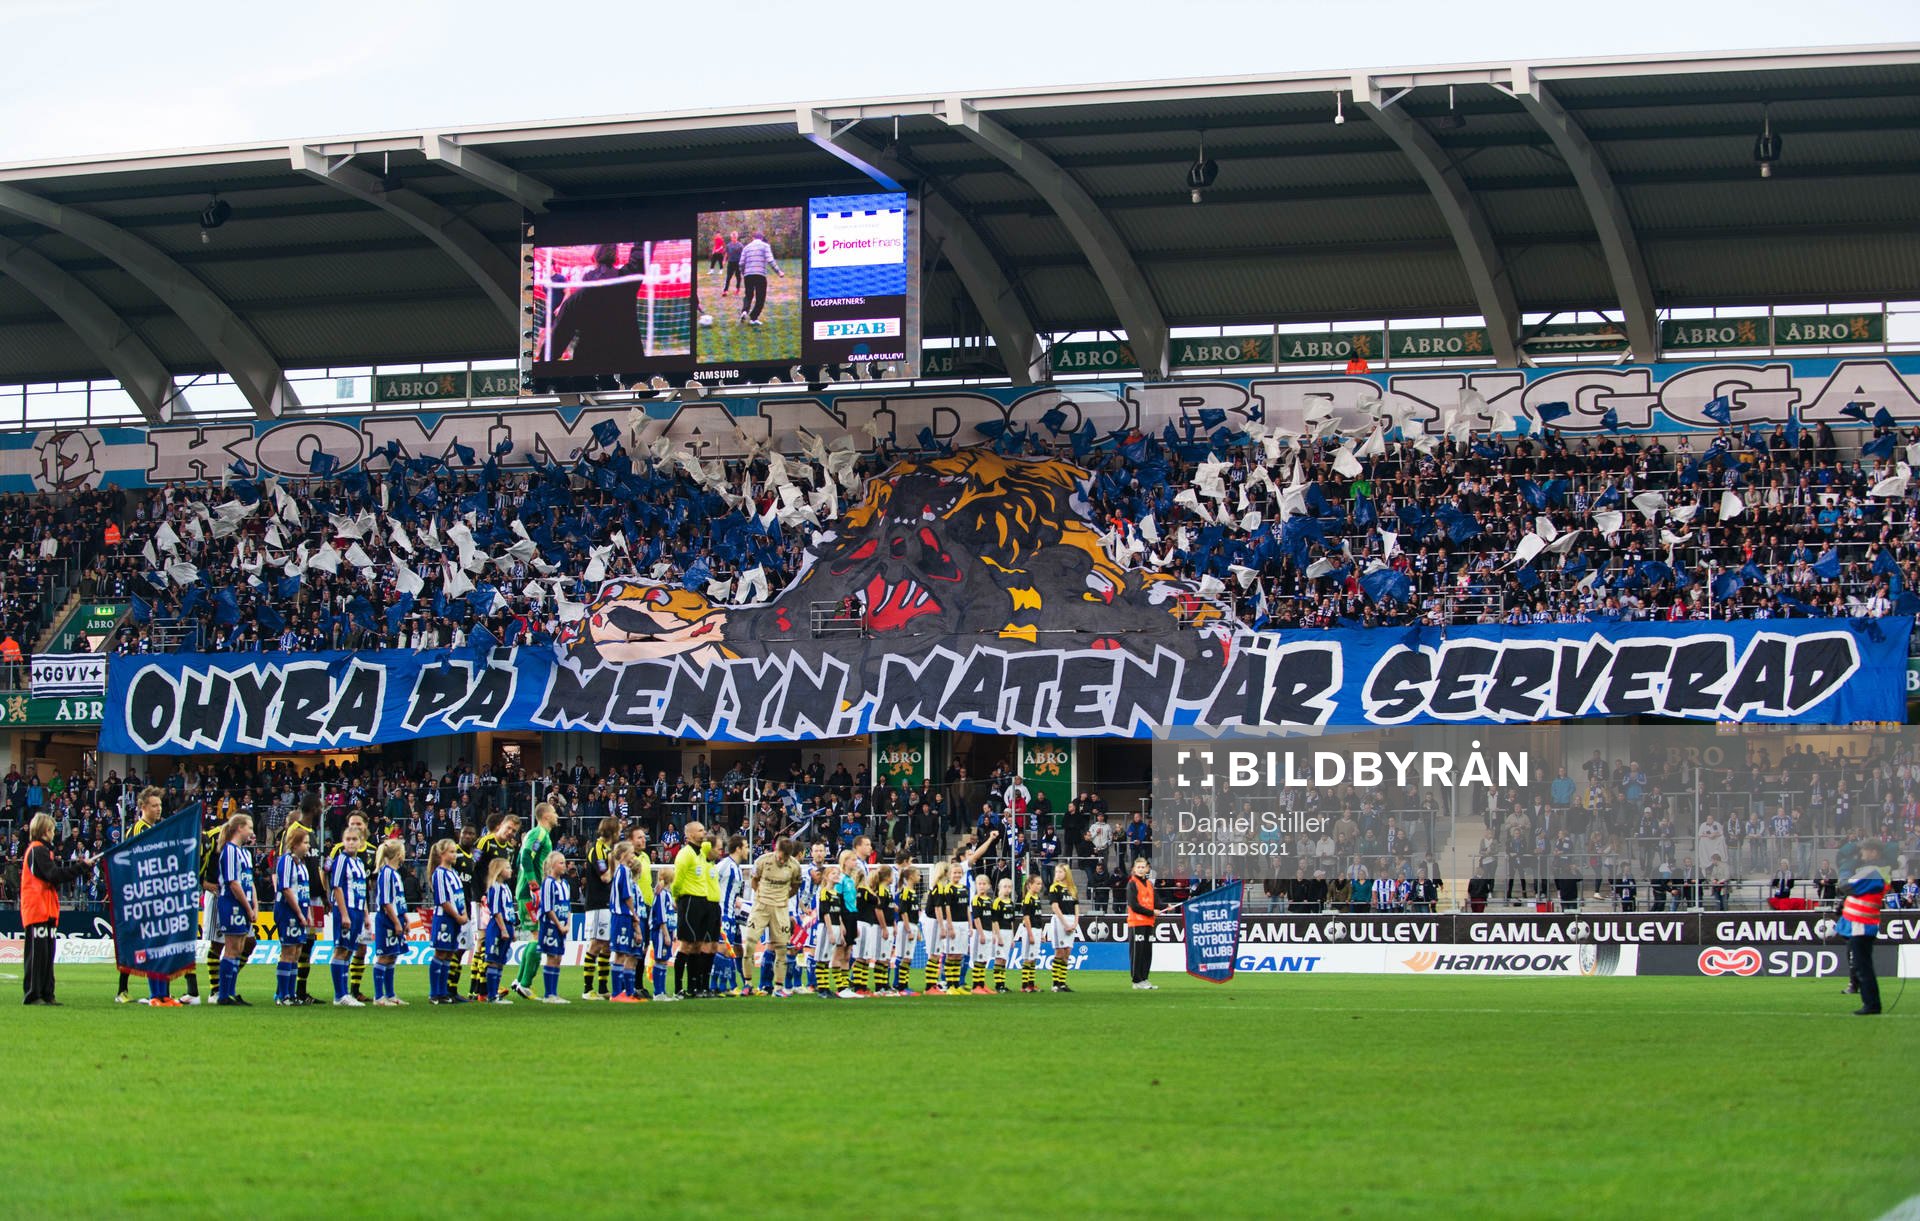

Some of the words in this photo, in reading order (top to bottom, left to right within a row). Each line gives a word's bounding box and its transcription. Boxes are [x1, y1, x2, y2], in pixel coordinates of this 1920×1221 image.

[832, 237, 871, 250] Prioritet
[826, 322, 886, 337] PEAB
[1674, 326, 1735, 344] ÅBRO
[1787, 322, 1848, 341] ÅBRO
[1181, 344, 1241, 362] ÅBRO
[1290, 340, 1350, 358] ÅBRO
[1402, 336, 1462, 354] ÅBRO
[848, 353, 874, 362] GAMLA
[1058, 349, 1118, 368] ÅBRO
[693, 369, 739, 380] SAMSUNG
[386, 380, 438, 397] ÅBRO
[39, 430, 95, 487] 12
[86, 619, 114, 628] ÅBRO
[43, 666, 88, 681] GGVV
[125, 656, 387, 752] OHYRA
[400, 645, 519, 733] PÅ
[870, 642, 1186, 740] MATEN
[1193, 631, 1344, 739] ÄR
[1362, 631, 1861, 724] SERVERAD
[878, 750, 922, 764] ÅBRO
[1024, 750, 1068, 765] ÅBRO
[137, 855, 179, 877] HELA
[122, 870, 198, 902] SVERIGES
[123, 891, 199, 921] FOTBOLLS
[230, 915, 247, 926] ICA
[1202, 909, 1228, 921] HELA
[140, 914, 190, 940] KLUBB
[286, 927, 302, 938] ICA
[1192, 920, 1238, 935] SVERIGES
[1350, 922, 1437, 942] ULLEVI
[1469, 922, 1564, 942] GAMLA
[1593, 921, 1682, 942] ULLEVI
[1716, 921, 1813, 941] GAMLA
[543, 936, 559, 947] ICA
[616, 935, 629, 945] ICA
[1192, 933, 1237, 946] FOTBOLL
[1202, 945, 1234, 958] KLUBB
